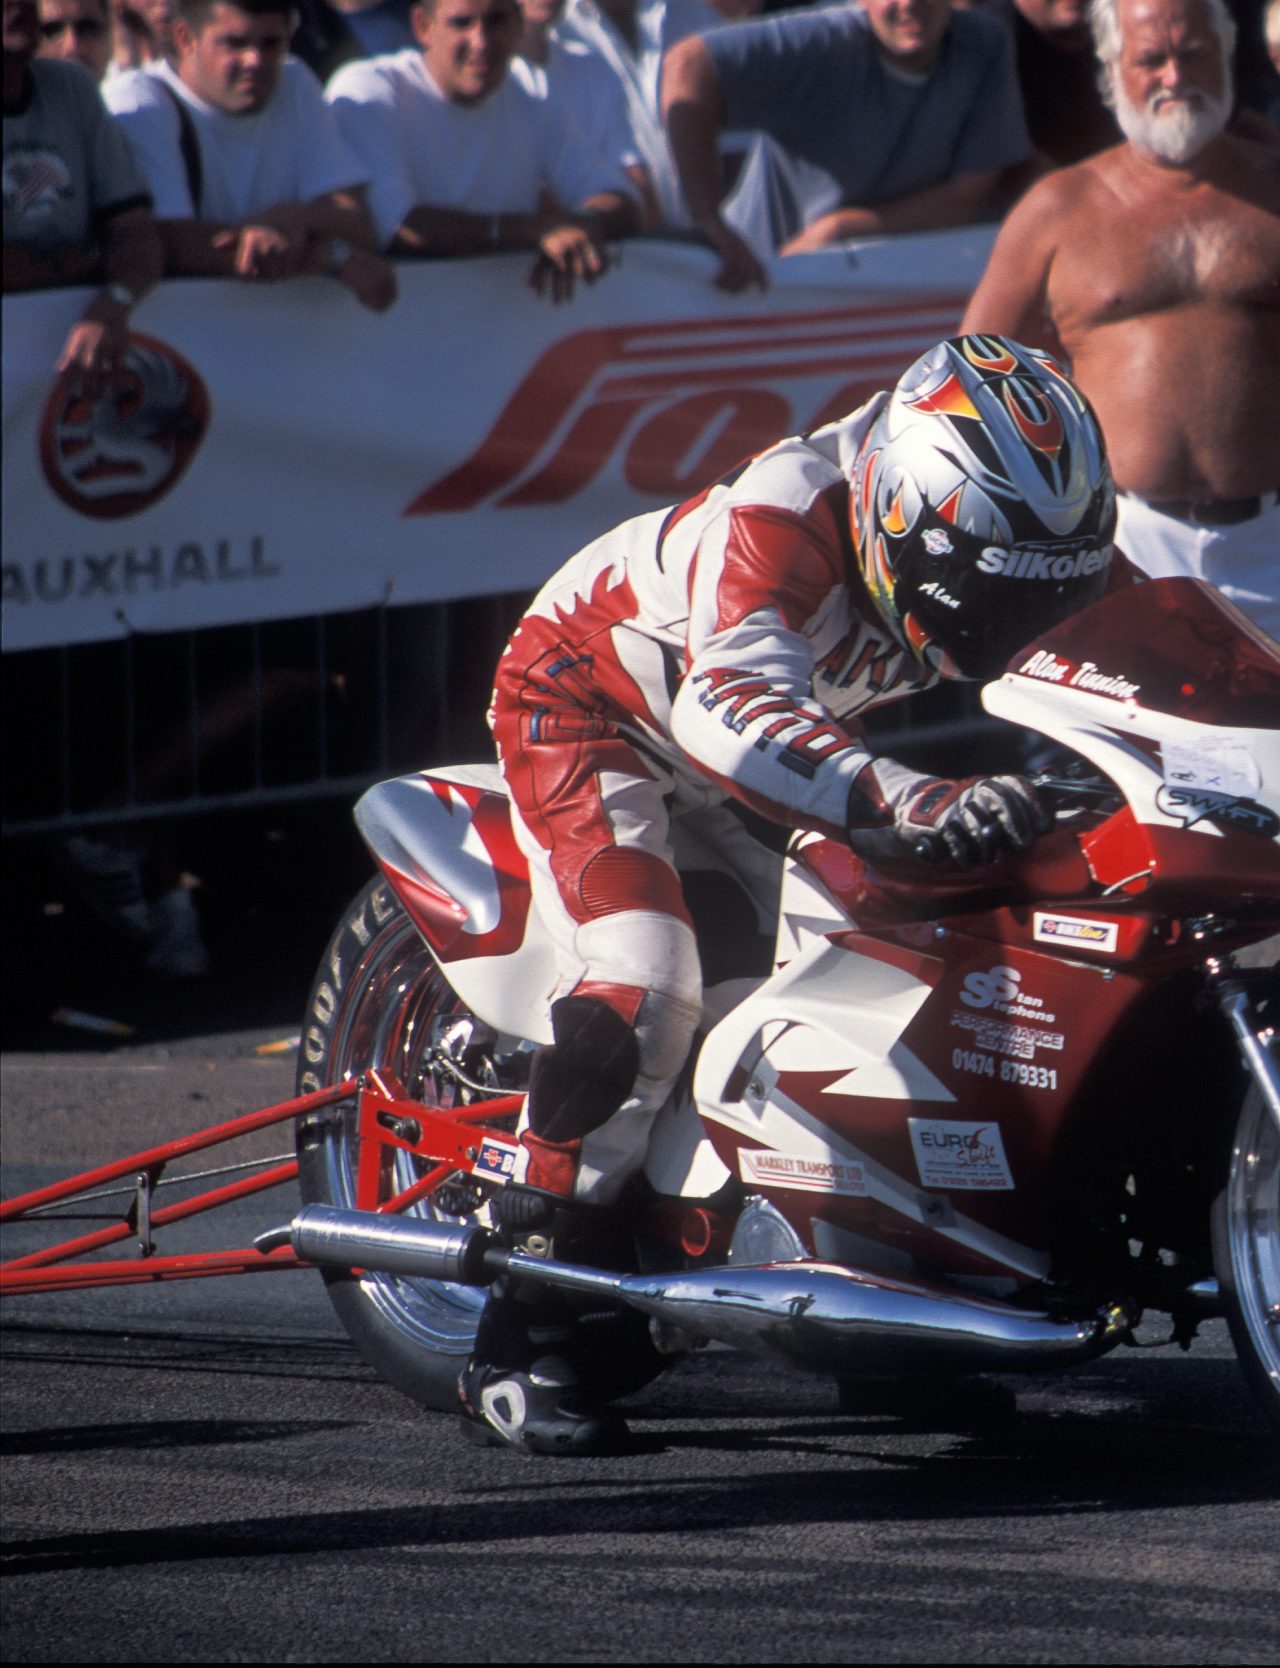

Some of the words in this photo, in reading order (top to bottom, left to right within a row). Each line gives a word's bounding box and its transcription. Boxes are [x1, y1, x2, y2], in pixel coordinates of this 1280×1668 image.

[918, 582, 962, 609] Alan
[1018, 649, 1070, 682] Alan
[1168, 788, 1273, 829] SWIFT
[952, 1048, 995, 1078] 01474
[1000, 1060, 1057, 1090] 879331
[920, 1131, 980, 1150] EURO
[796, 1159, 845, 1178] TRANSPORT
